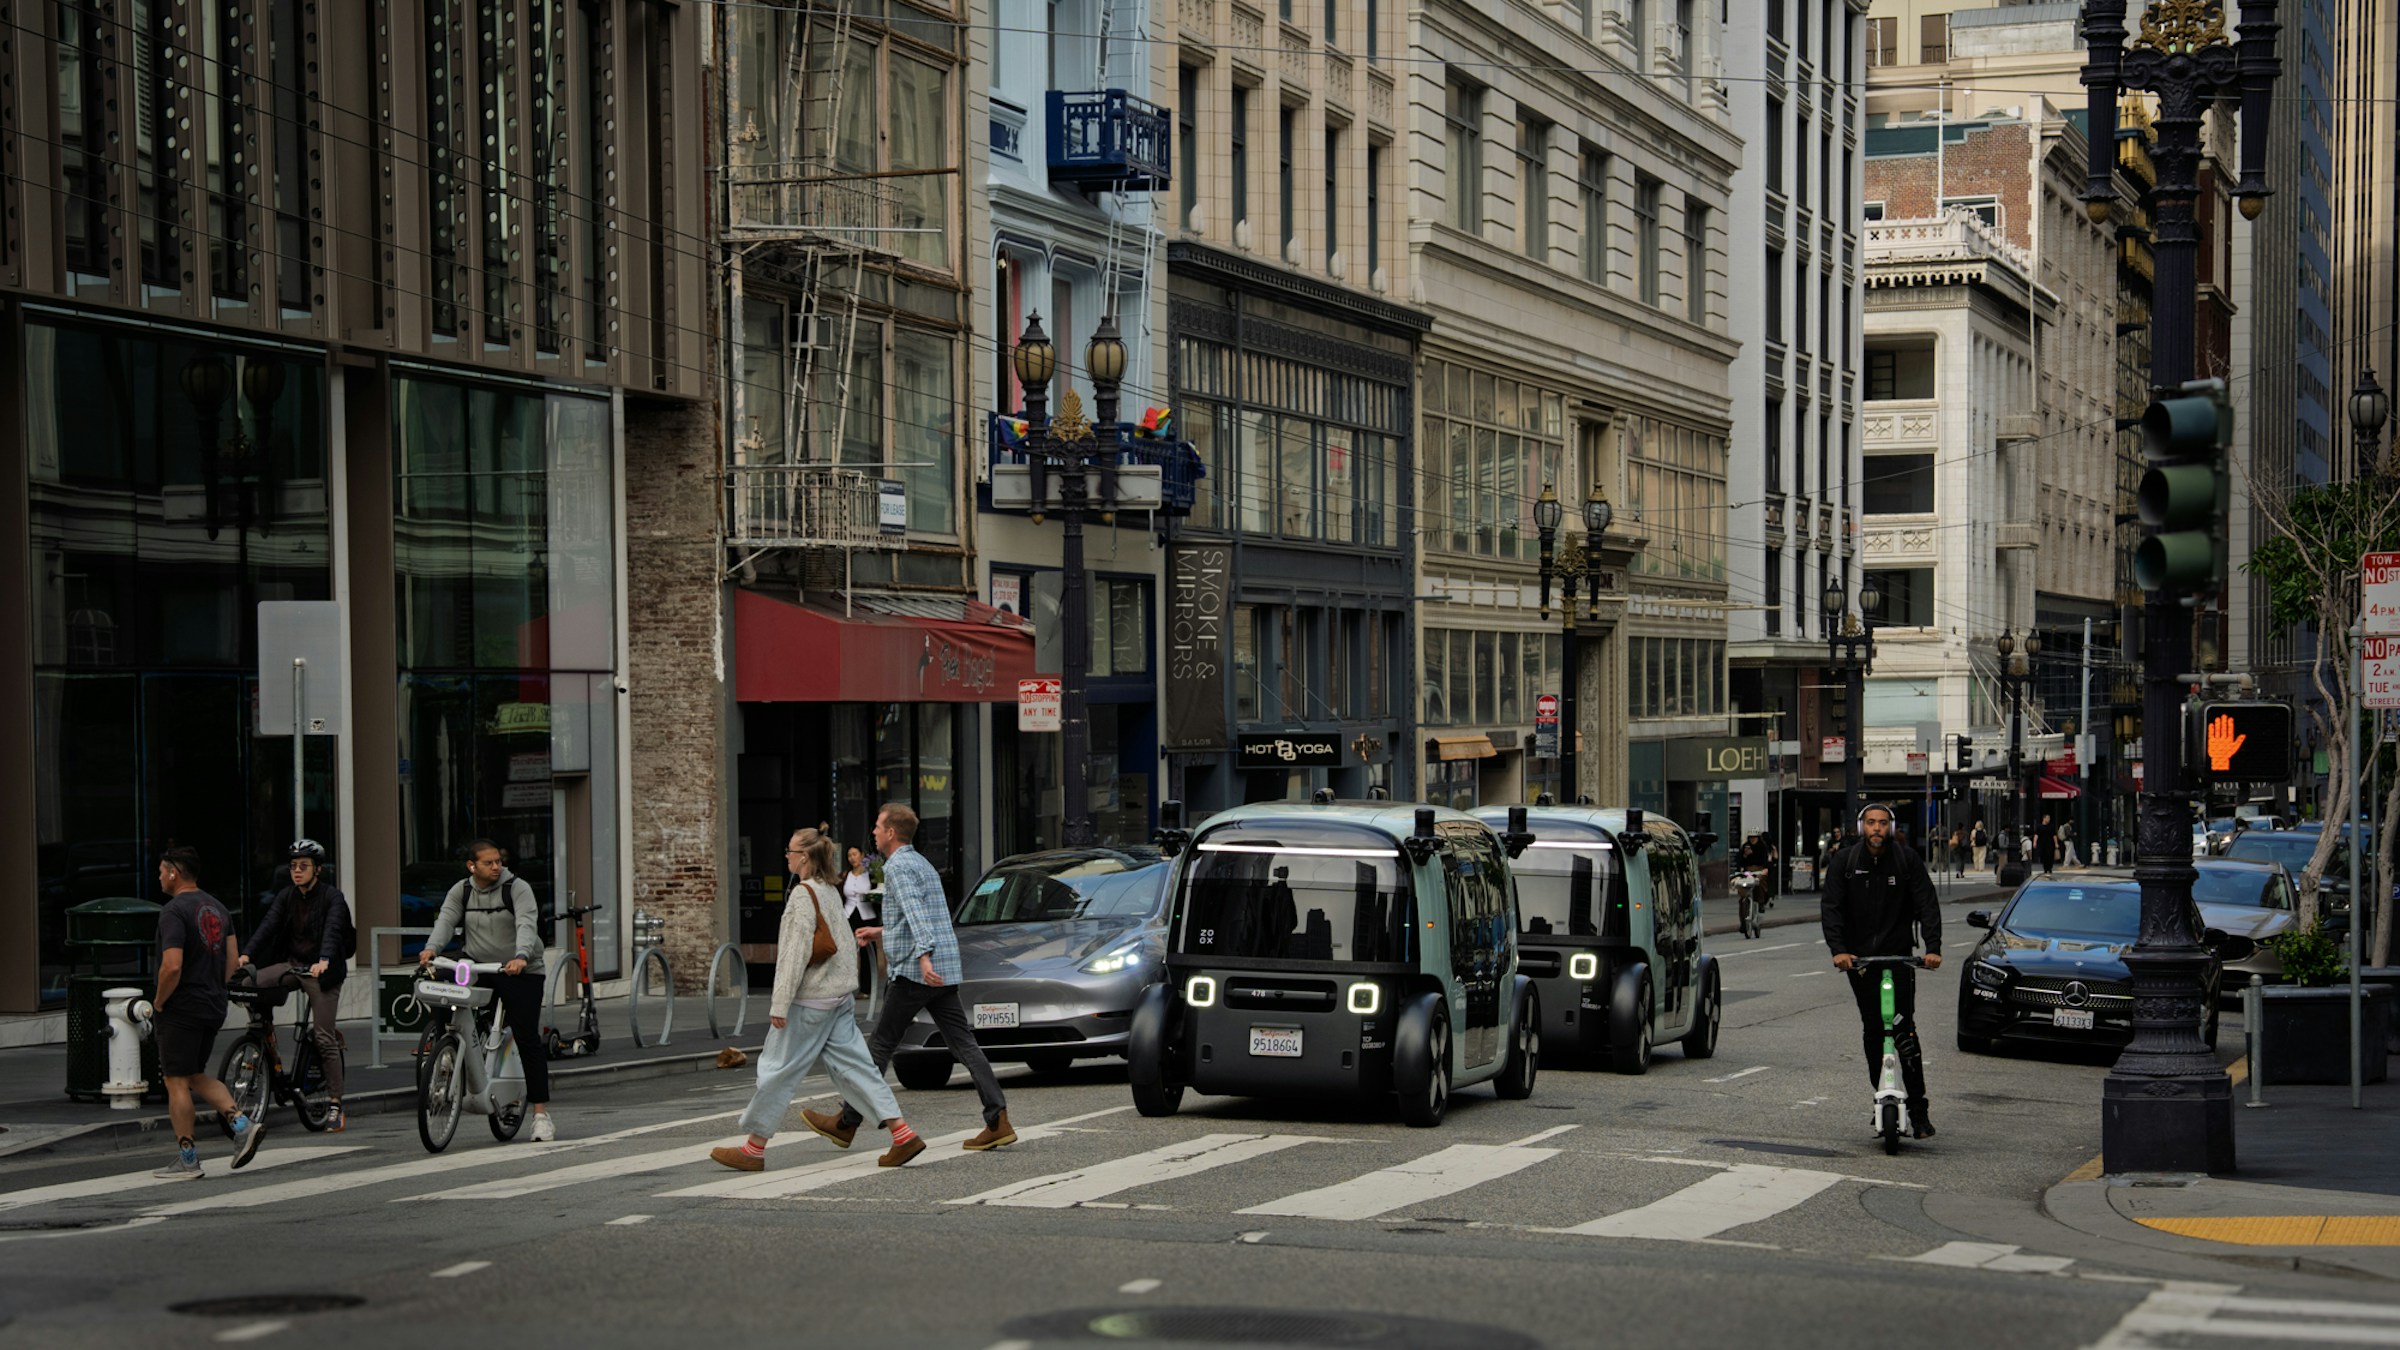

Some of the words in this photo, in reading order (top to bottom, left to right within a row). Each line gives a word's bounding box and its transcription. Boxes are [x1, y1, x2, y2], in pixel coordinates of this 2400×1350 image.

[890, 503, 905, 517] LEASE
[2371, 555, 2393, 565] TOW
[2365, 567, 2388, 584] NO
[1196, 550, 1224, 651] SMOKE
[1173, 550, 1199, 680] MIRRORS
[2370, 603, 2378, 616] 4
[2365, 640, 2386, 658] NO
[1195, 661, 1217, 679] &
[2373, 663, 2381, 676] 2
[2369, 682, 2389, 693] TUE
[1020, 691, 1031, 703] NO
[1032, 694, 1059, 702] STOPPING
[2369, 697, 2395, 705] STREET
[1023, 707, 1037, 717] ANY
[1042, 707, 1057, 717] TIME
[1182, 738, 1211, 746] SALON
[1245, 744, 1274, 754] HOT
[1295, 744, 1334, 754] YOGA
[1251, 988, 1266, 998] 478
[977, 1012, 1015, 1025] 9PYH551
[1253, 1038, 1298, 1052] 95186G4
